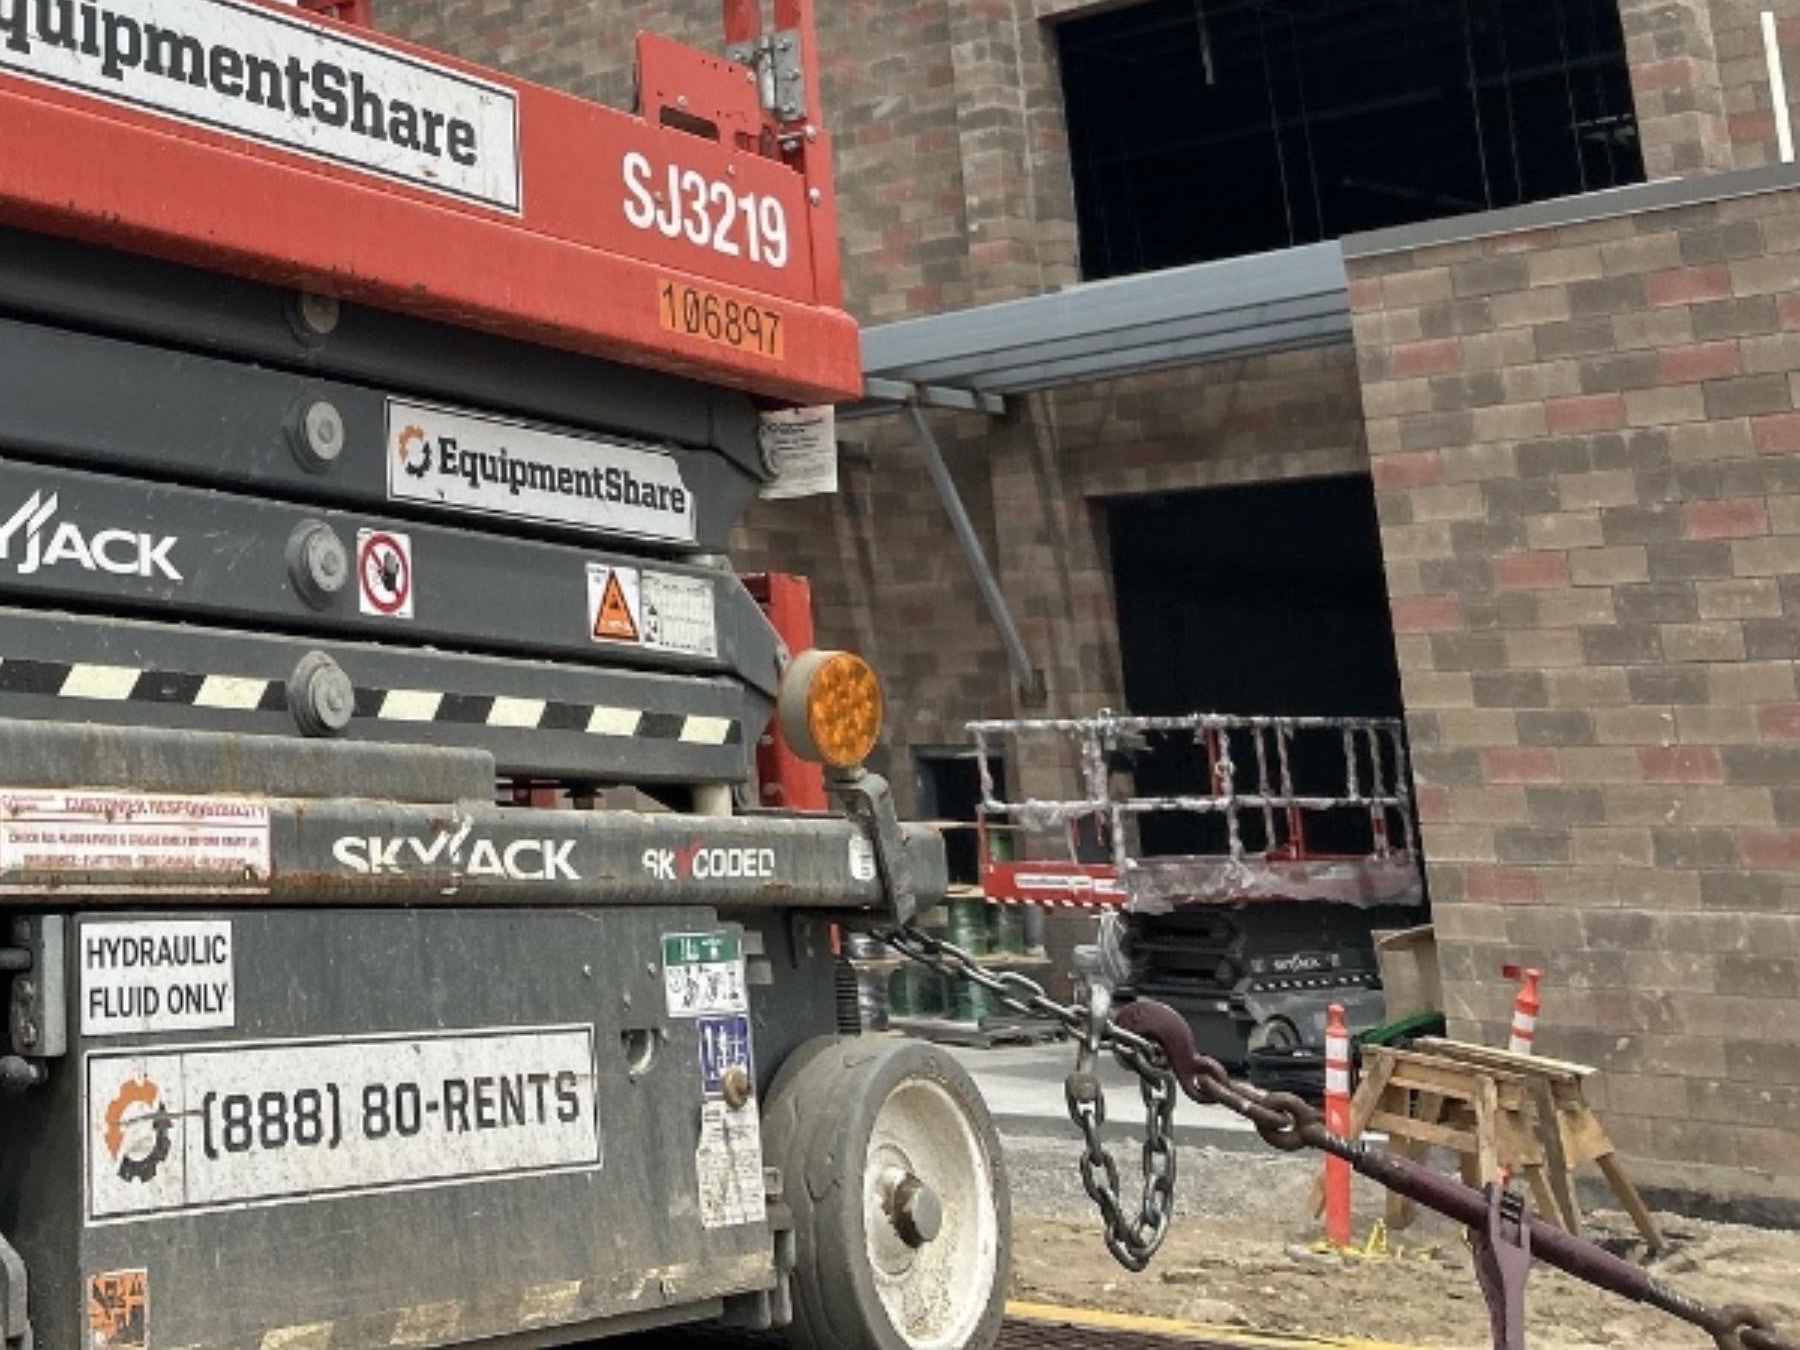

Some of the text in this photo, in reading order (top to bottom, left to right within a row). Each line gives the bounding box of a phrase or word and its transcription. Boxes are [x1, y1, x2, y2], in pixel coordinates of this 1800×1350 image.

[622, 151, 788, 269] SJ3219
[663, 282, 781, 355] 106897
[437, 435, 686, 514] EquipmentShare
[86, 934, 227, 970] HYDRAULIC
[89, 981, 229, 1019] FLUID ONLY
[202, 1069, 581, 1160] (888) 80-RENTS
